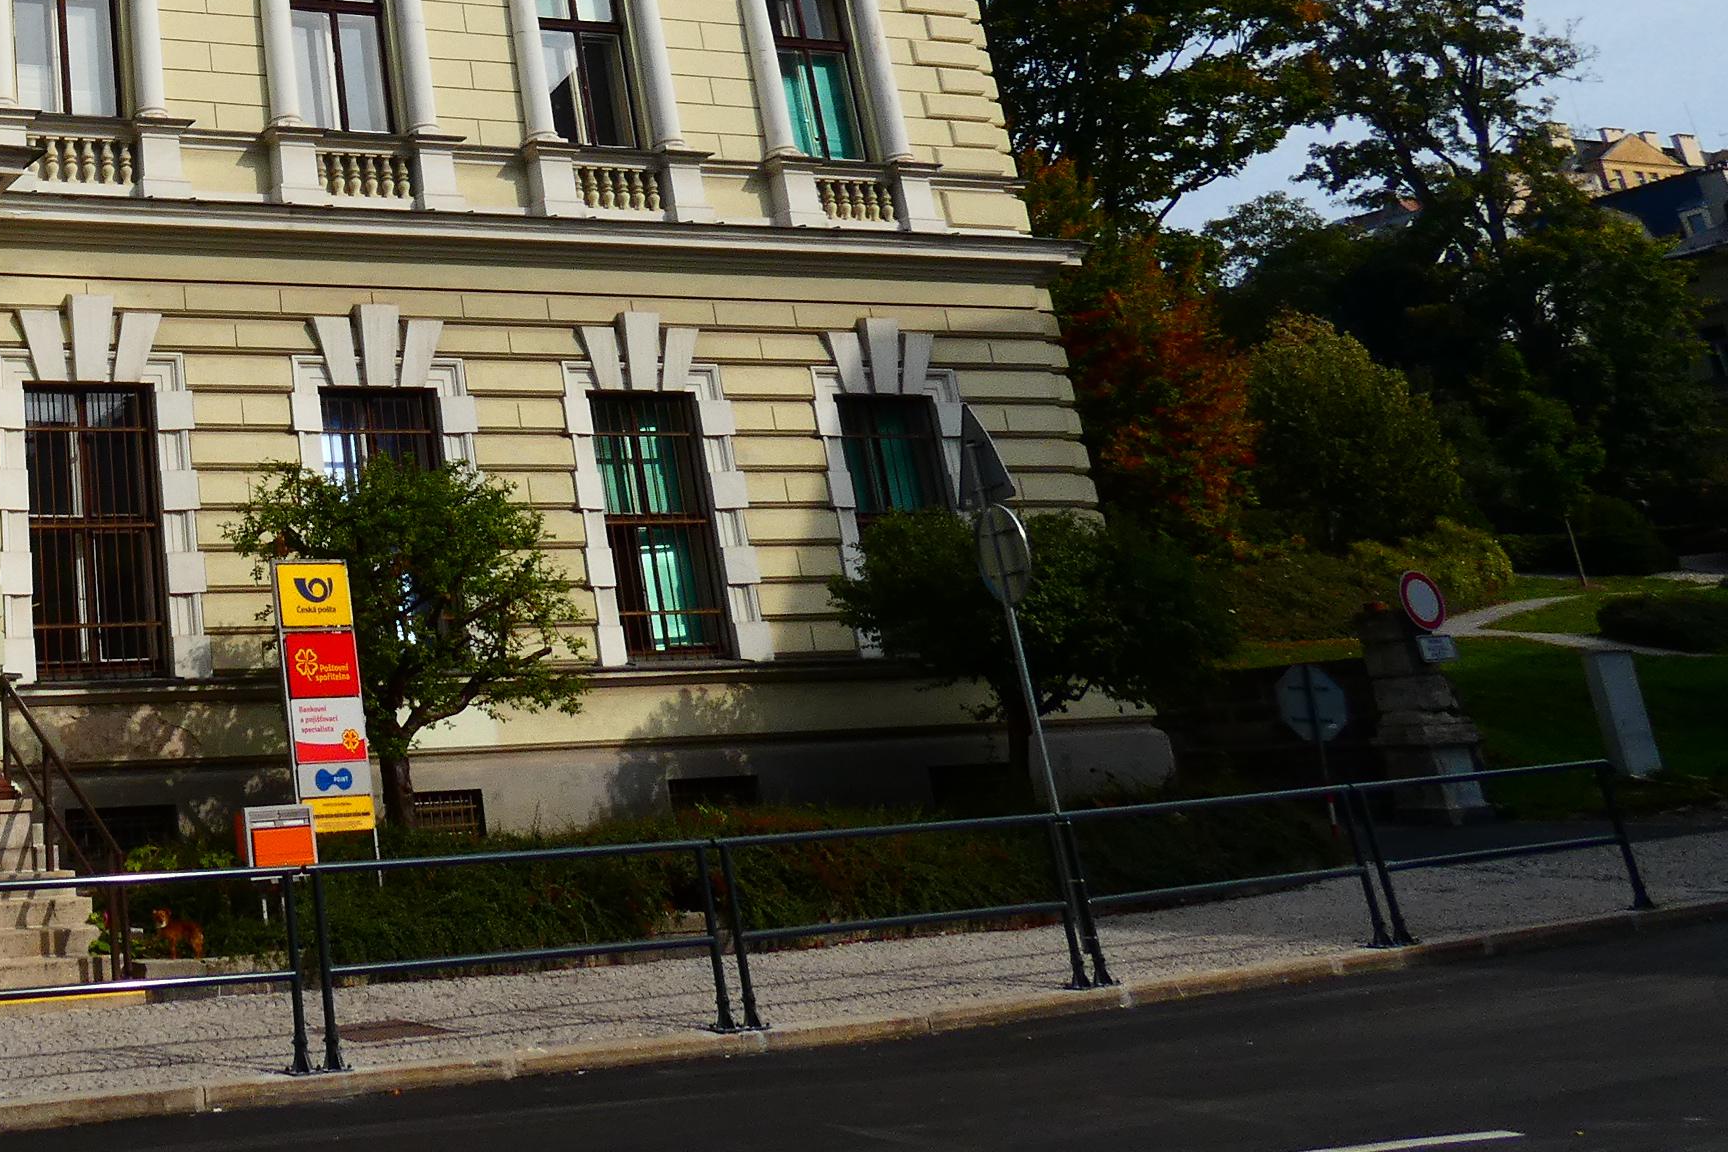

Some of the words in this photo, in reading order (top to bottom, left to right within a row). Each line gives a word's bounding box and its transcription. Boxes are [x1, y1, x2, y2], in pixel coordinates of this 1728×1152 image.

[296, 605, 317, 614] Česká
[317, 605, 337, 614] pošta
[319, 662, 349, 672] Poštovní
[315, 672, 351, 683] spořitelna
[333, 775, 349, 783] POINT
